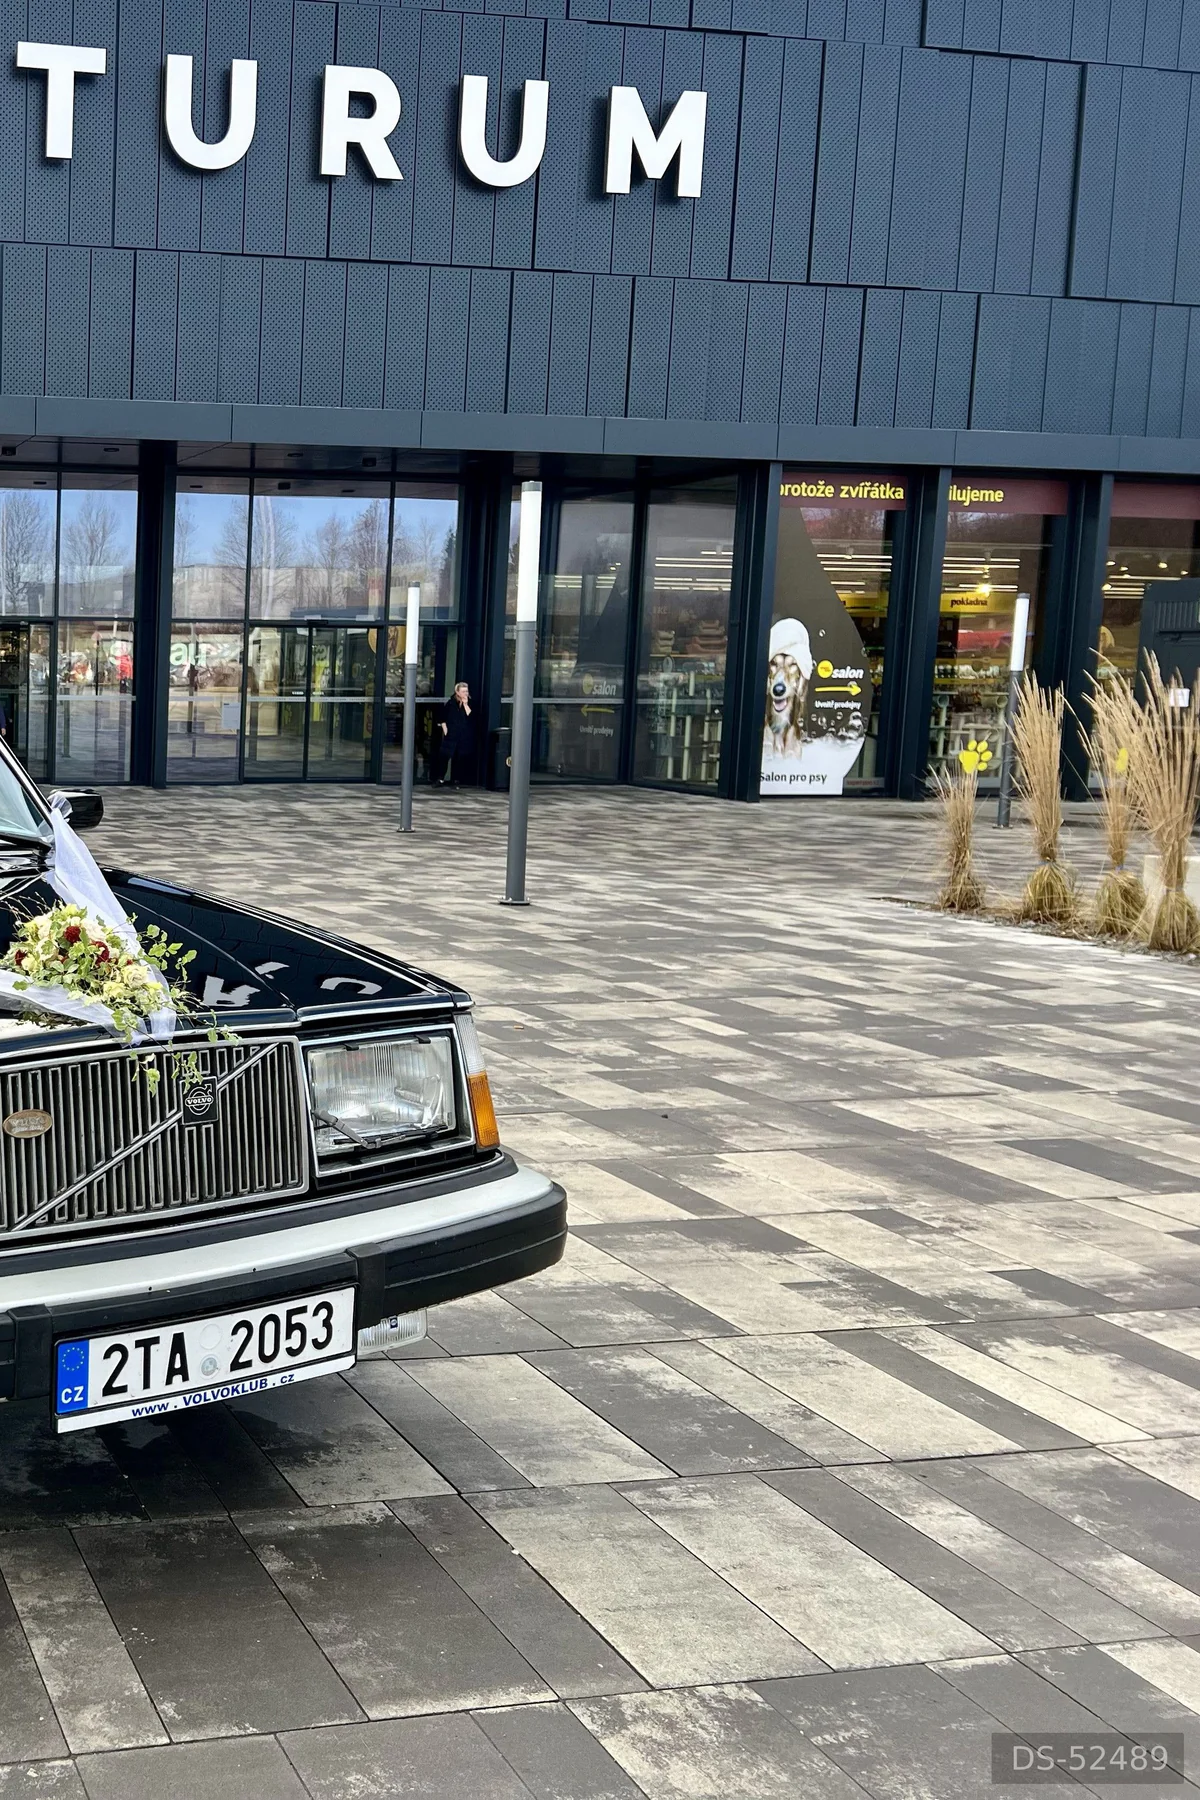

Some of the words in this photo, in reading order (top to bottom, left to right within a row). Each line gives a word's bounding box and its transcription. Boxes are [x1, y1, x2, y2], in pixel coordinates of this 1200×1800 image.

[839, 482, 905, 500] zvířátka
[948, 485, 1005, 507] ilujeme
[950, 597, 988, 608] pokladna
[831, 665, 865, 679] salon
[591, 681, 617, 696] salon
[760, 771, 787, 782] Salon
[789, 774, 807, 785] pro
[809, 774, 828, 785] psy
[187, 1097, 212, 1105] VOLVO
[101, 1331, 190, 1397] 2TA
[229, 1300, 334, 1373] 2053
[60, 1386, 84, 1404] CZ
